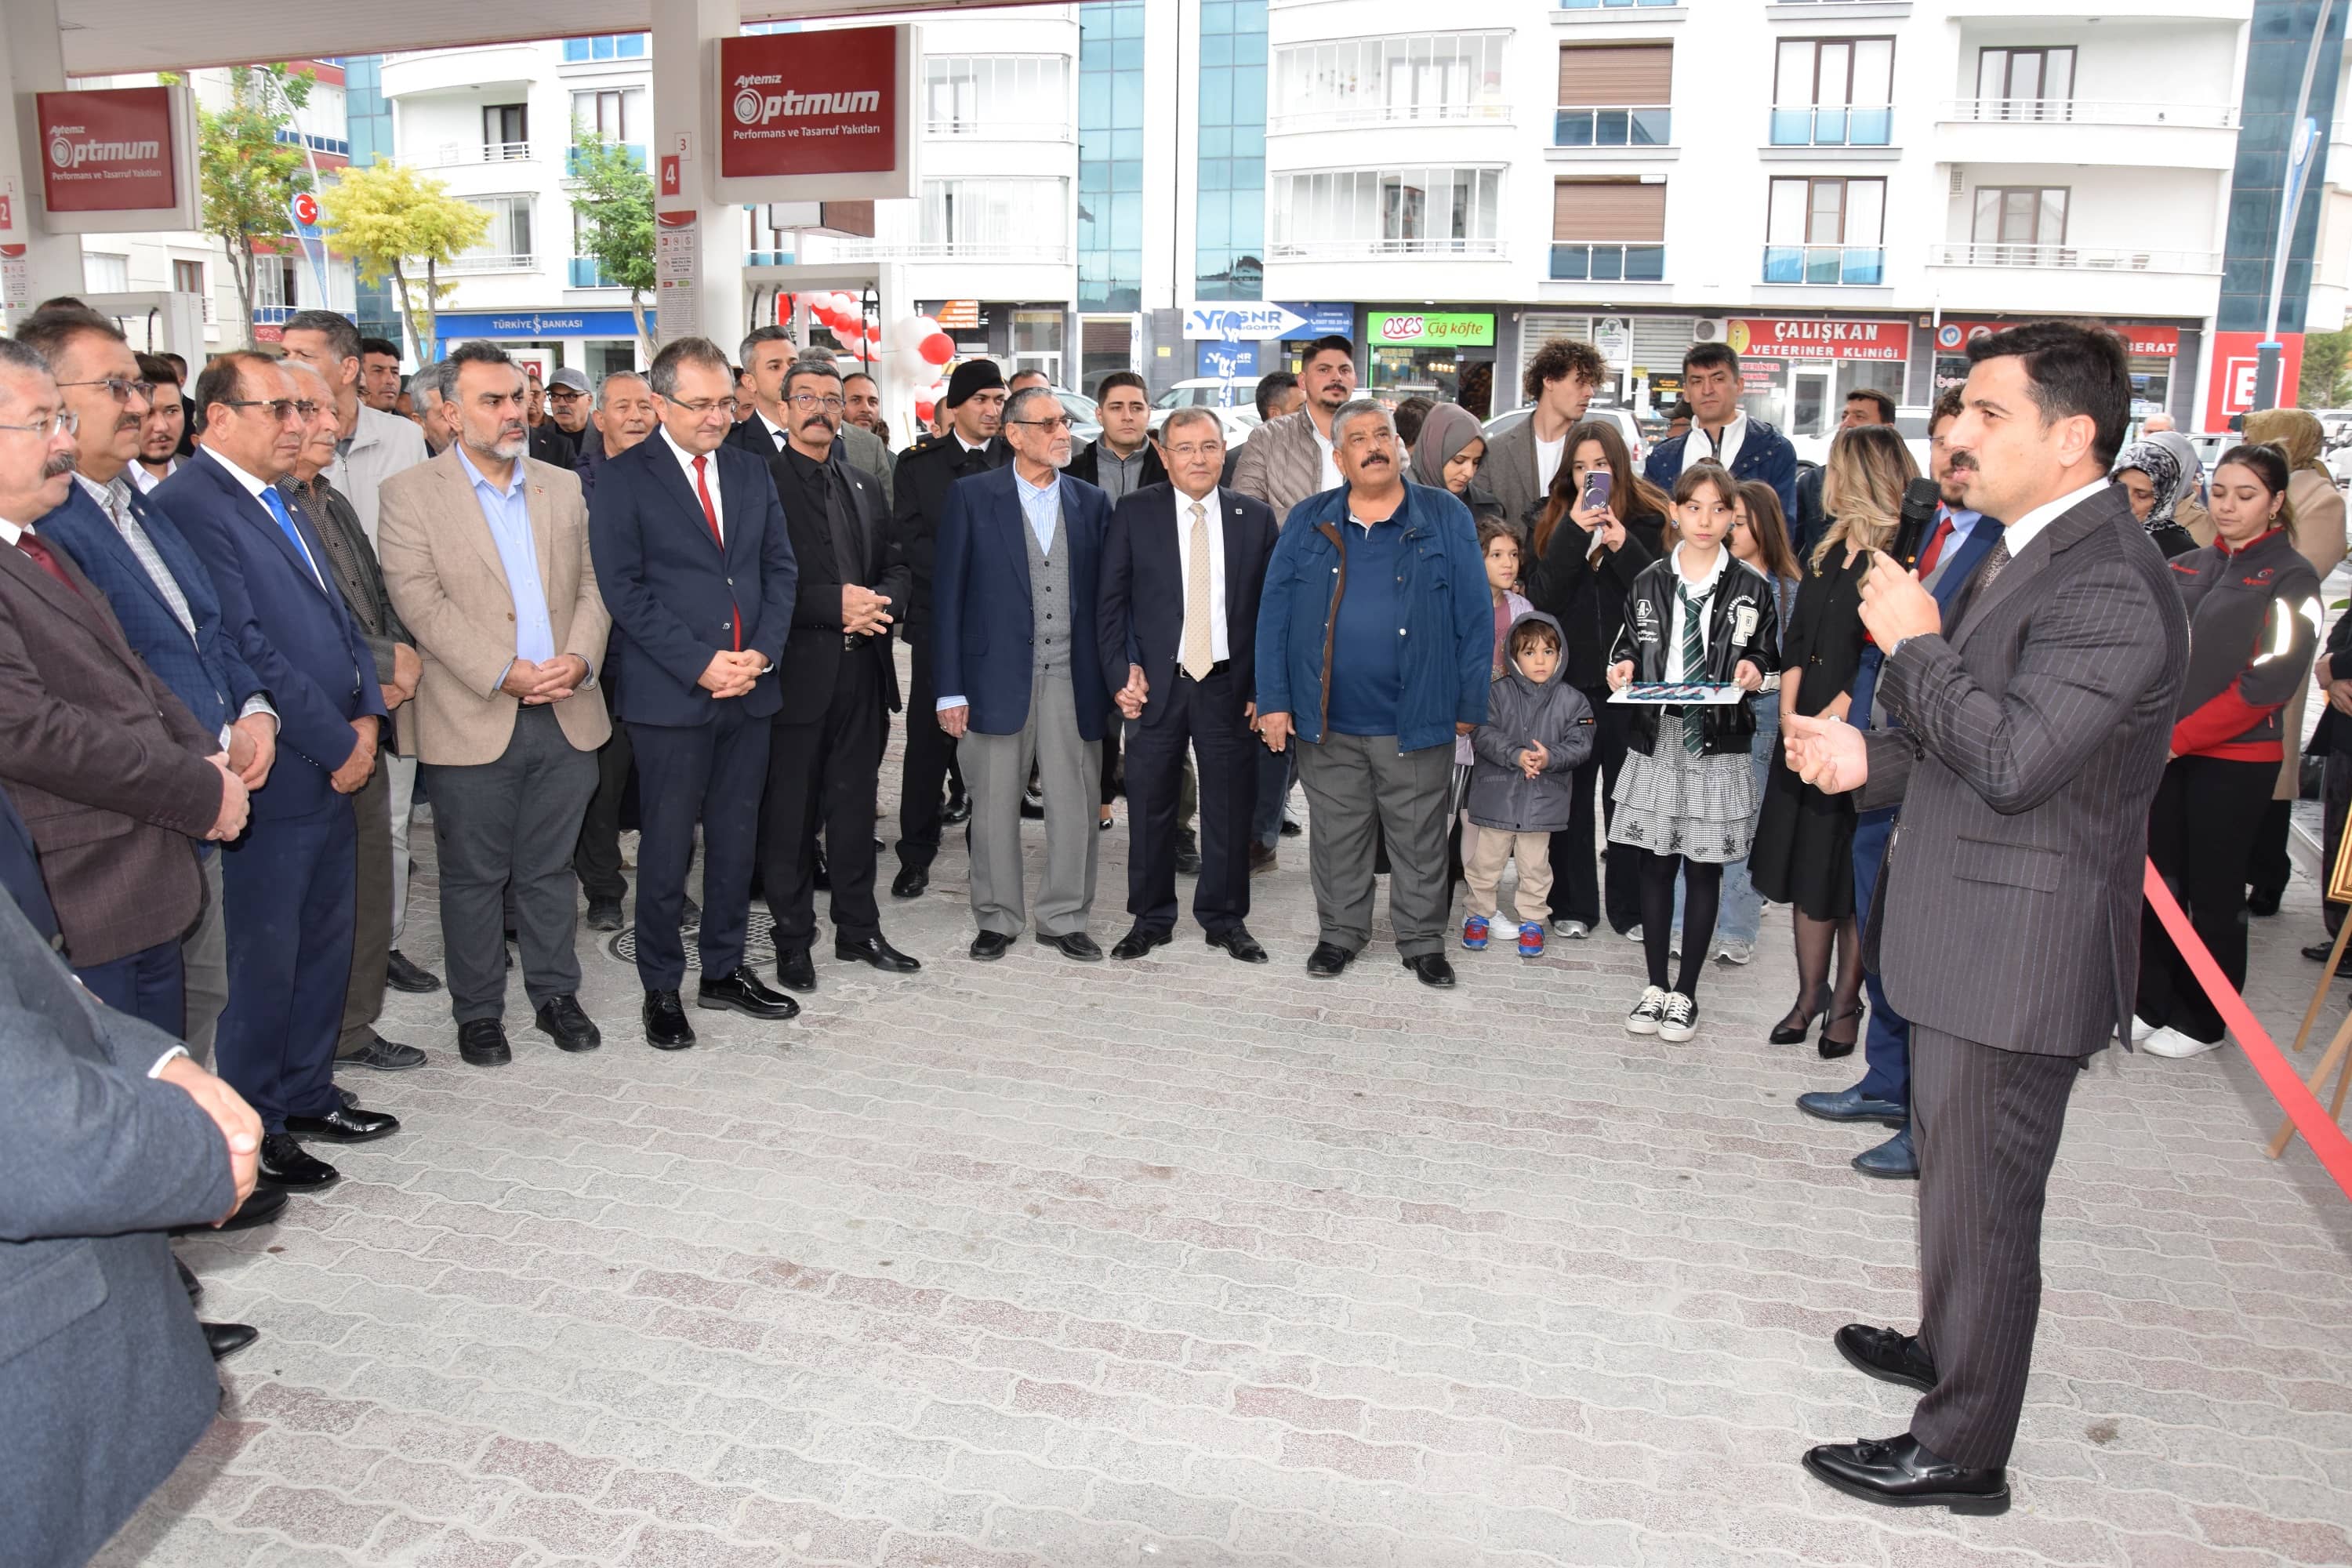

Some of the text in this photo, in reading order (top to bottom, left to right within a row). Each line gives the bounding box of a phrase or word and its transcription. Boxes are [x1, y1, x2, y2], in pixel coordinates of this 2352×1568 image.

[733, 129, 786, 140] Performans
[801, 125, 840, 137] Tasarruf
[841, 123, 880, 135] Yakıtları
[680, 138, 687, 151] 3
[52, 172, 92, 181] Performans
[103, 169, 131, 179] Tasarruf
[665, 164, 676, 185] 4
[8, 181, 13, 192] 1
[0, 202, 9, 222] 2
[492, 320, 532, 329] TÜRKİYE
[542, 320, 583, 328] BANKASI
[1428, 322, 1447, 336] Çiğ
[1450, 322, 1483, 338] köfte
[1774, 322, 1878, 343] ÇALIŞKAN
[1732, 604, 1759, 647] P
